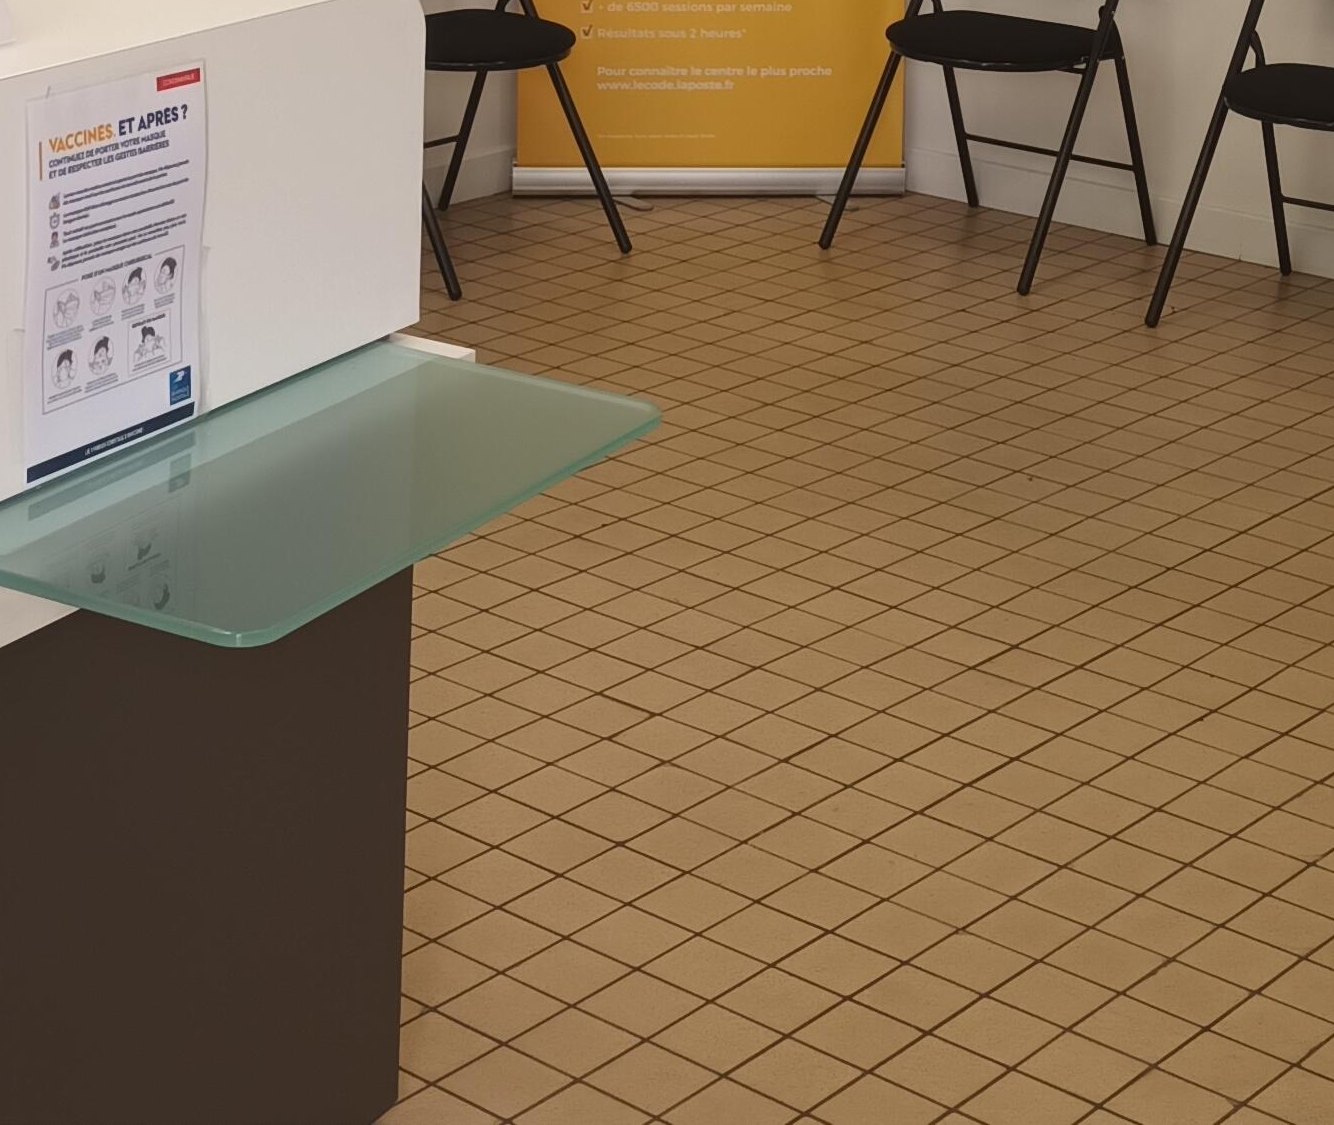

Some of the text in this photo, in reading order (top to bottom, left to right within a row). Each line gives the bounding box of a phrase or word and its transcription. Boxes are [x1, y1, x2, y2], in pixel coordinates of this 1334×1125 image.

[607, 2, 623, 12] de
[662, 2, 713, 12] sessions
[716, 3, 736, 14] par
[739, 2, 792, 12] semaine
[658, 29, 687, 39] sous
[690, 28, 697, 39] 2
[597, 66, 627, 77] Pour
[691, 66, 702, 77] le
[704, 67, 744, 77] centre
[747, 66, 758, 77] le
[760, 66, 786, 78] plus
[789, 66, 833, 78] proche
[118, 117, 136, 137] ET
[180, 103, 188, 119] ?
[86, 147, 95, 158] DE
[48, 170, 57, 179] ET
[58, 167, 67, 177] DE
